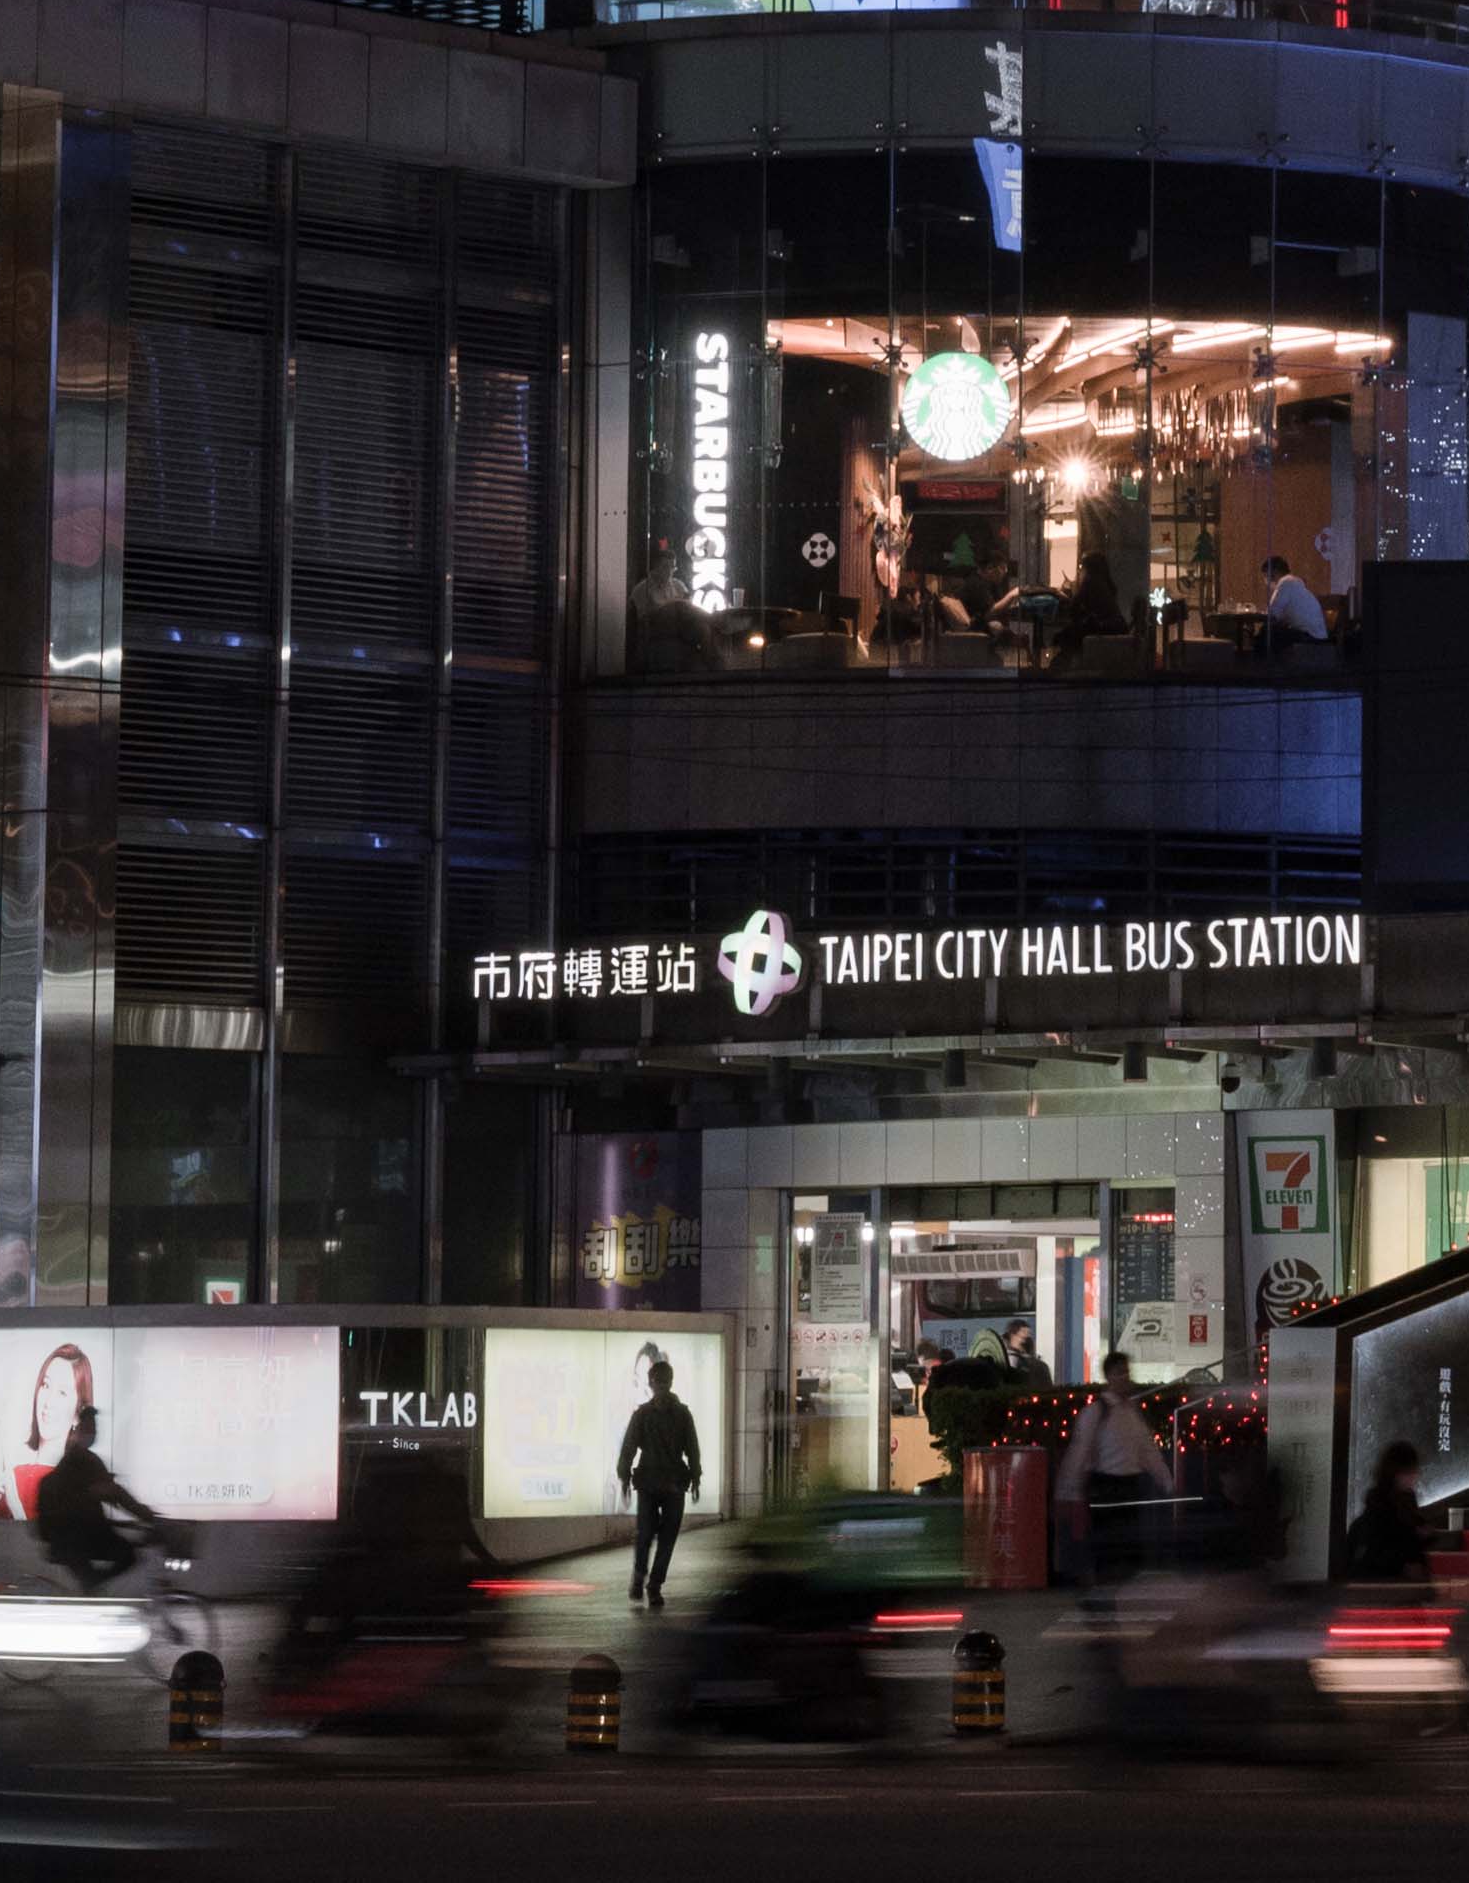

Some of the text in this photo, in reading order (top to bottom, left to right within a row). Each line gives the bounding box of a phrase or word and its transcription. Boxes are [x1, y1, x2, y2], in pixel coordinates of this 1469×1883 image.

[692, 330, 730, 614] STARBUCKS
[472, 914, 1362, 1002] 市府轉運站 TAIPEI CITY HALL BUS STATION
[582, 1217, 701, 1281] 刮刮樂
[358, 1390, 478, 1429] TKLAB
[392, 1437, 420, 1451] Since
